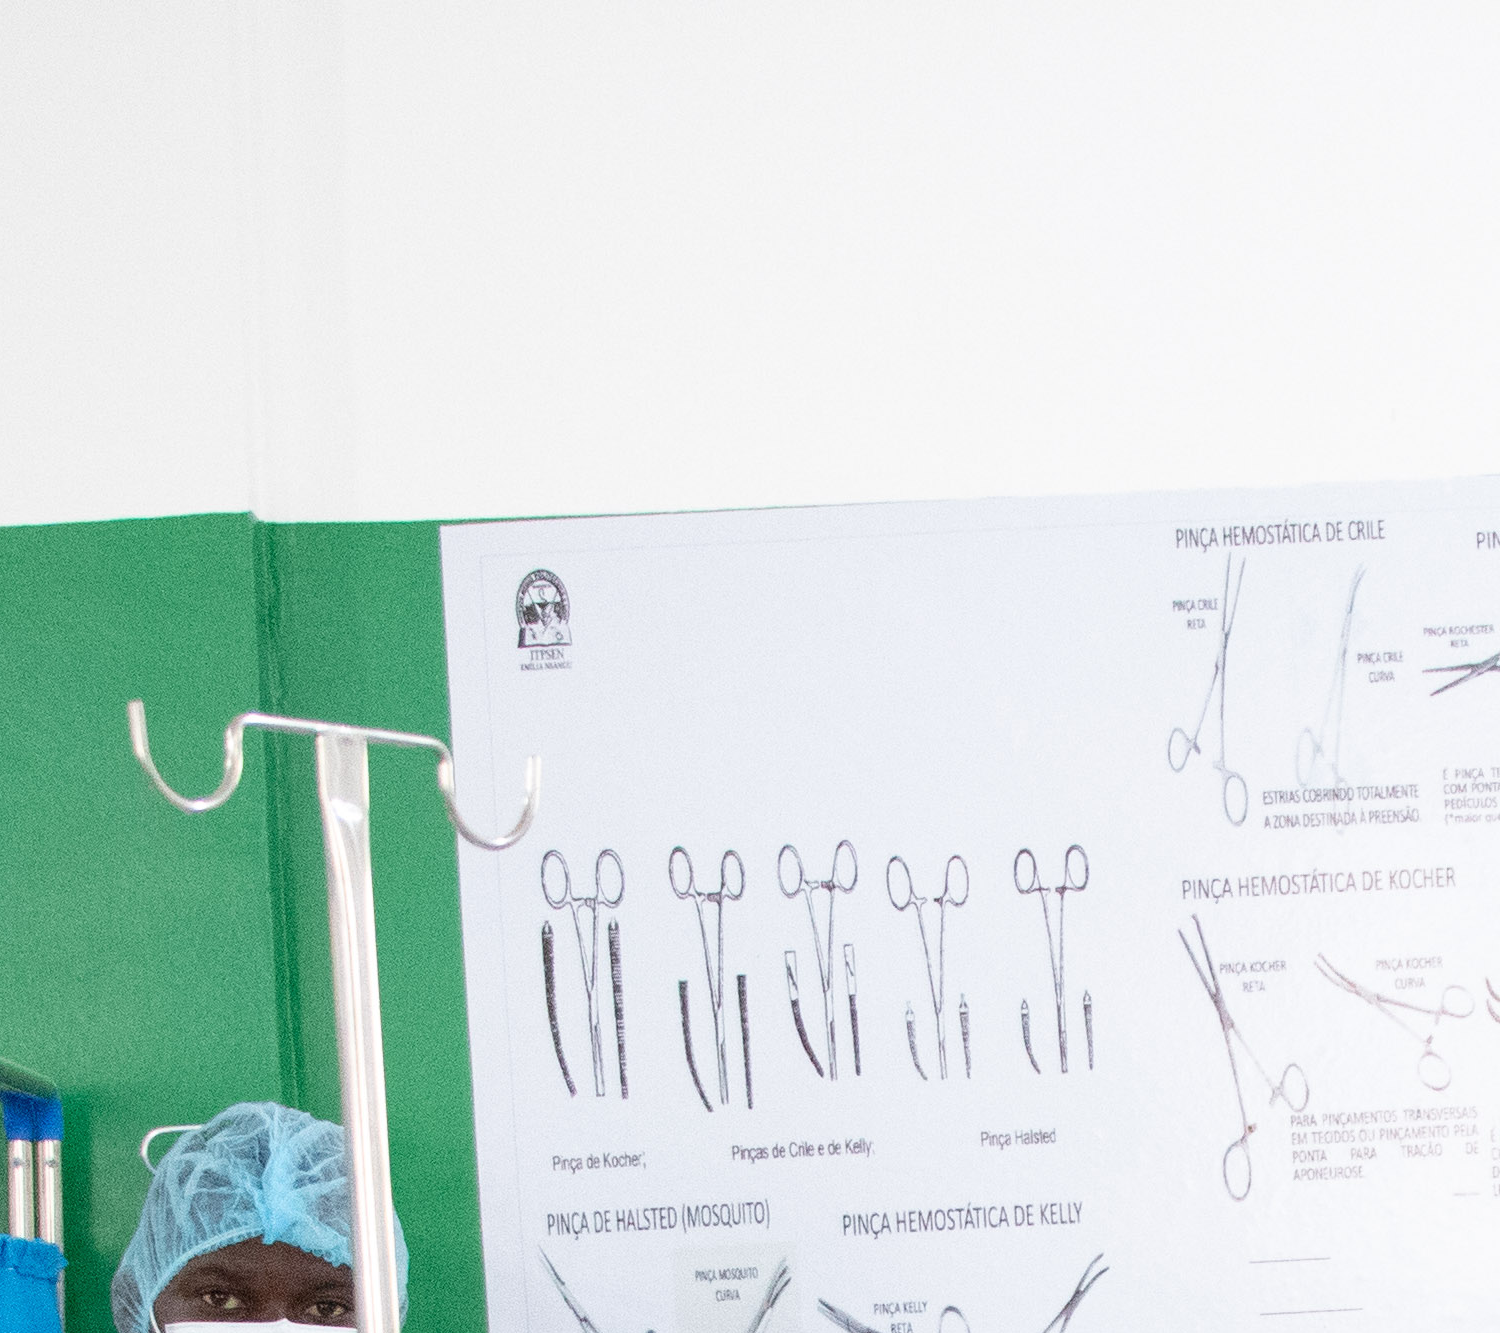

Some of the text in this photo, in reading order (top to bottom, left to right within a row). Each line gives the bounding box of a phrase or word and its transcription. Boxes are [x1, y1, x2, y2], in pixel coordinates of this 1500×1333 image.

[1175, 519, 1386, 553] PINÇA HEMOSTÁTICA DE CRILE
[1172, 598, 1218, 614] PINÇA CRILE
[1187, 618, 1206, 630] RETA
[1423, 626, 1447, 639] PINÇA
[1357, 651, 1403, 667] PINÇA CRILE
[1455, 766, 1484, 781] PINÇA
[1262, 783, 1420, 806] ESTRIAS COBRINDO TOTALMENTE
[1443, 783, 1467, 796] COM
[1273, 811, 1357, 829] ZONA DESTINADA
[1181, 867, 1457, 904] PINÇA HEMOSTÁTICA DE KOCHER
[1219, 959, 1287, 976] PINÇA KOCHER
[1375, 956, 1443, 972] PINÇA KOCHER
[1242, 980, 1266, 993] RETA
[1395, 977, 1426, 990] CURVA
[1290, 1106, 1478, 1128] PARA PINÇAMENTOS TRANSVERSAIS
[980, 1128, 1057, 1150] Pinça Halsted
[1291, 1123, 1479, 1146] EM TECIDOS OU PINÇAMENTO PELA
[731, 1140, 841, 1164] Pinças de Crile e de
[1292, 1141, 1480, 1164] PONTA PARA TRAÇÃO DE
[552, 1154, 600, 1174] Pinça de
[547, 1198, 770, 1240] PINÇA DE HALSTED (MOSQUITO)
[842, 1200, 1083, 1239] PINÇA HEMOSTÁTICA DE KELLY
[695, 1266, 759, 1284] PINÇA MOSQUITO
[715, 1289, 741, 1302] CURVA
[873, 1300, 927, 1317] PINÇA KELLY
